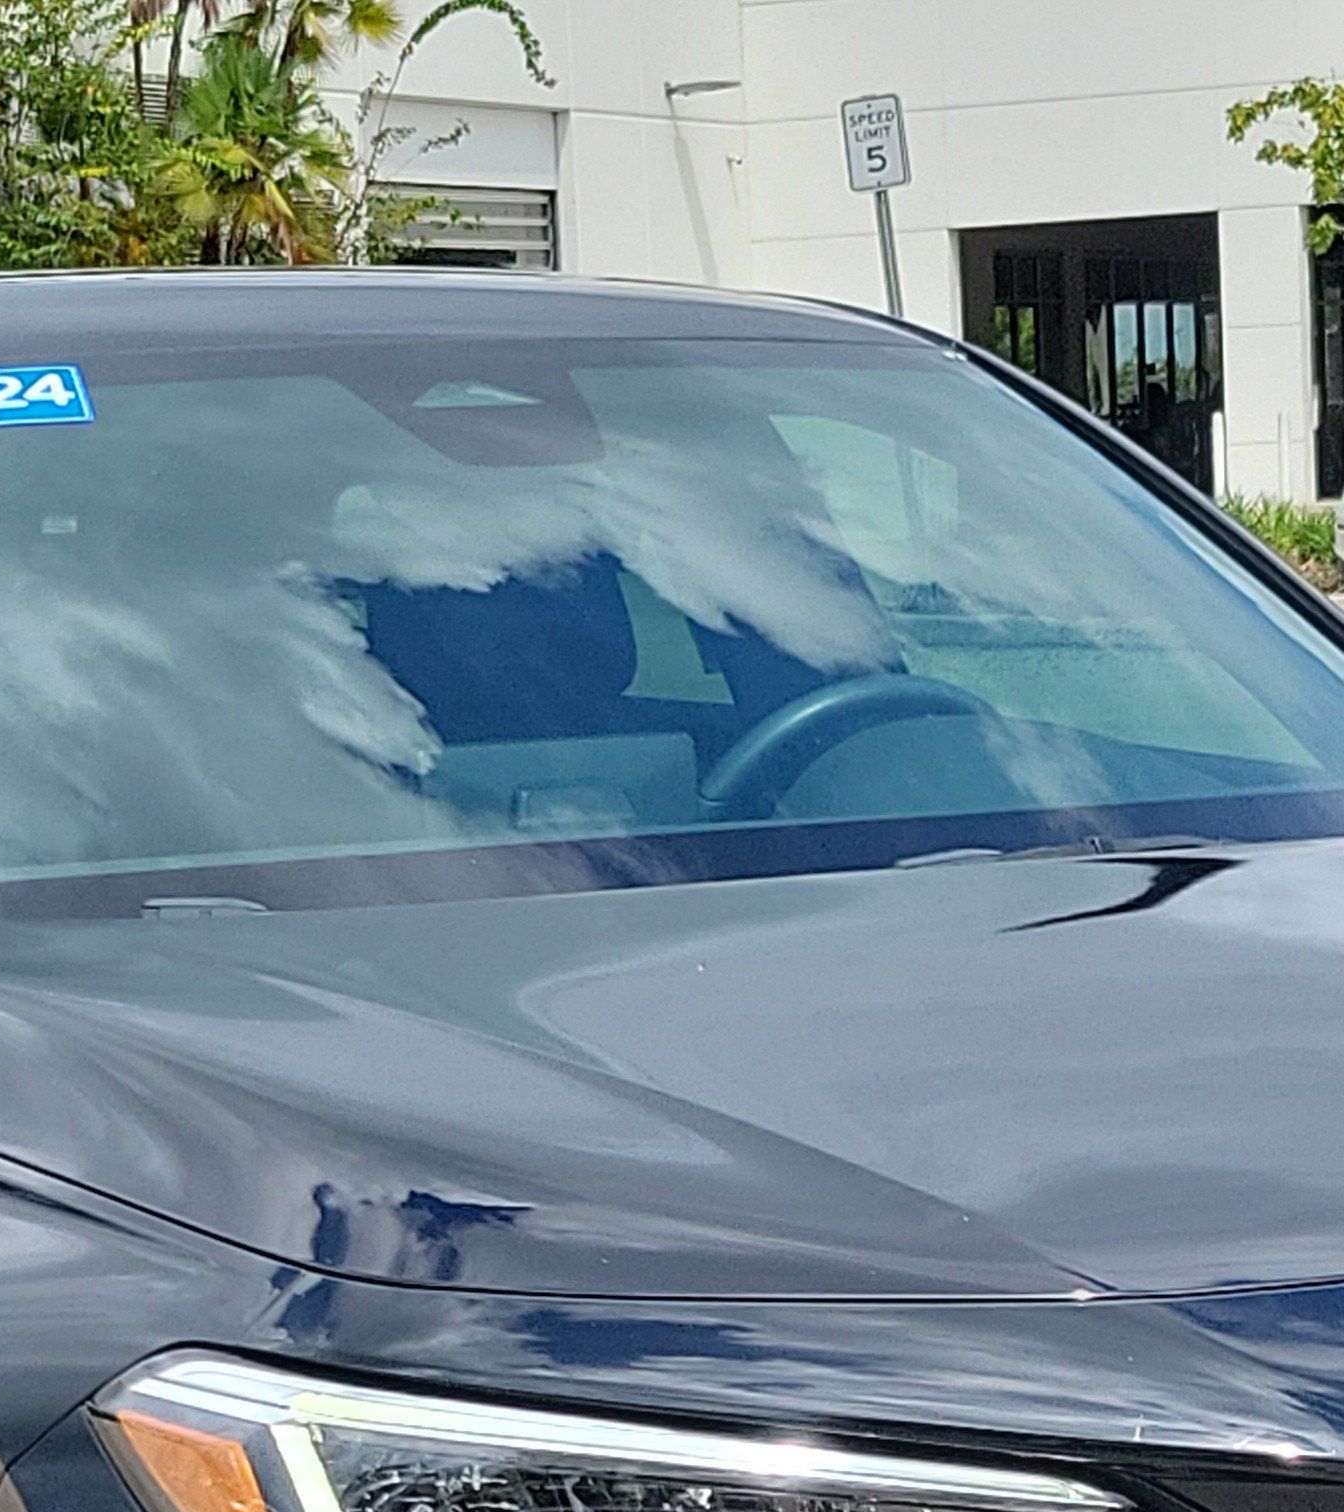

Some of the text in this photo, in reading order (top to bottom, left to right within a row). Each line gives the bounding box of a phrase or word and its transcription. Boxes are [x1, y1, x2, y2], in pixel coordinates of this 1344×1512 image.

[849, 110, 895, 127] SPEED
[854, 126, 891, 142] LIMIT
[866, 145, 887, 173] 5
